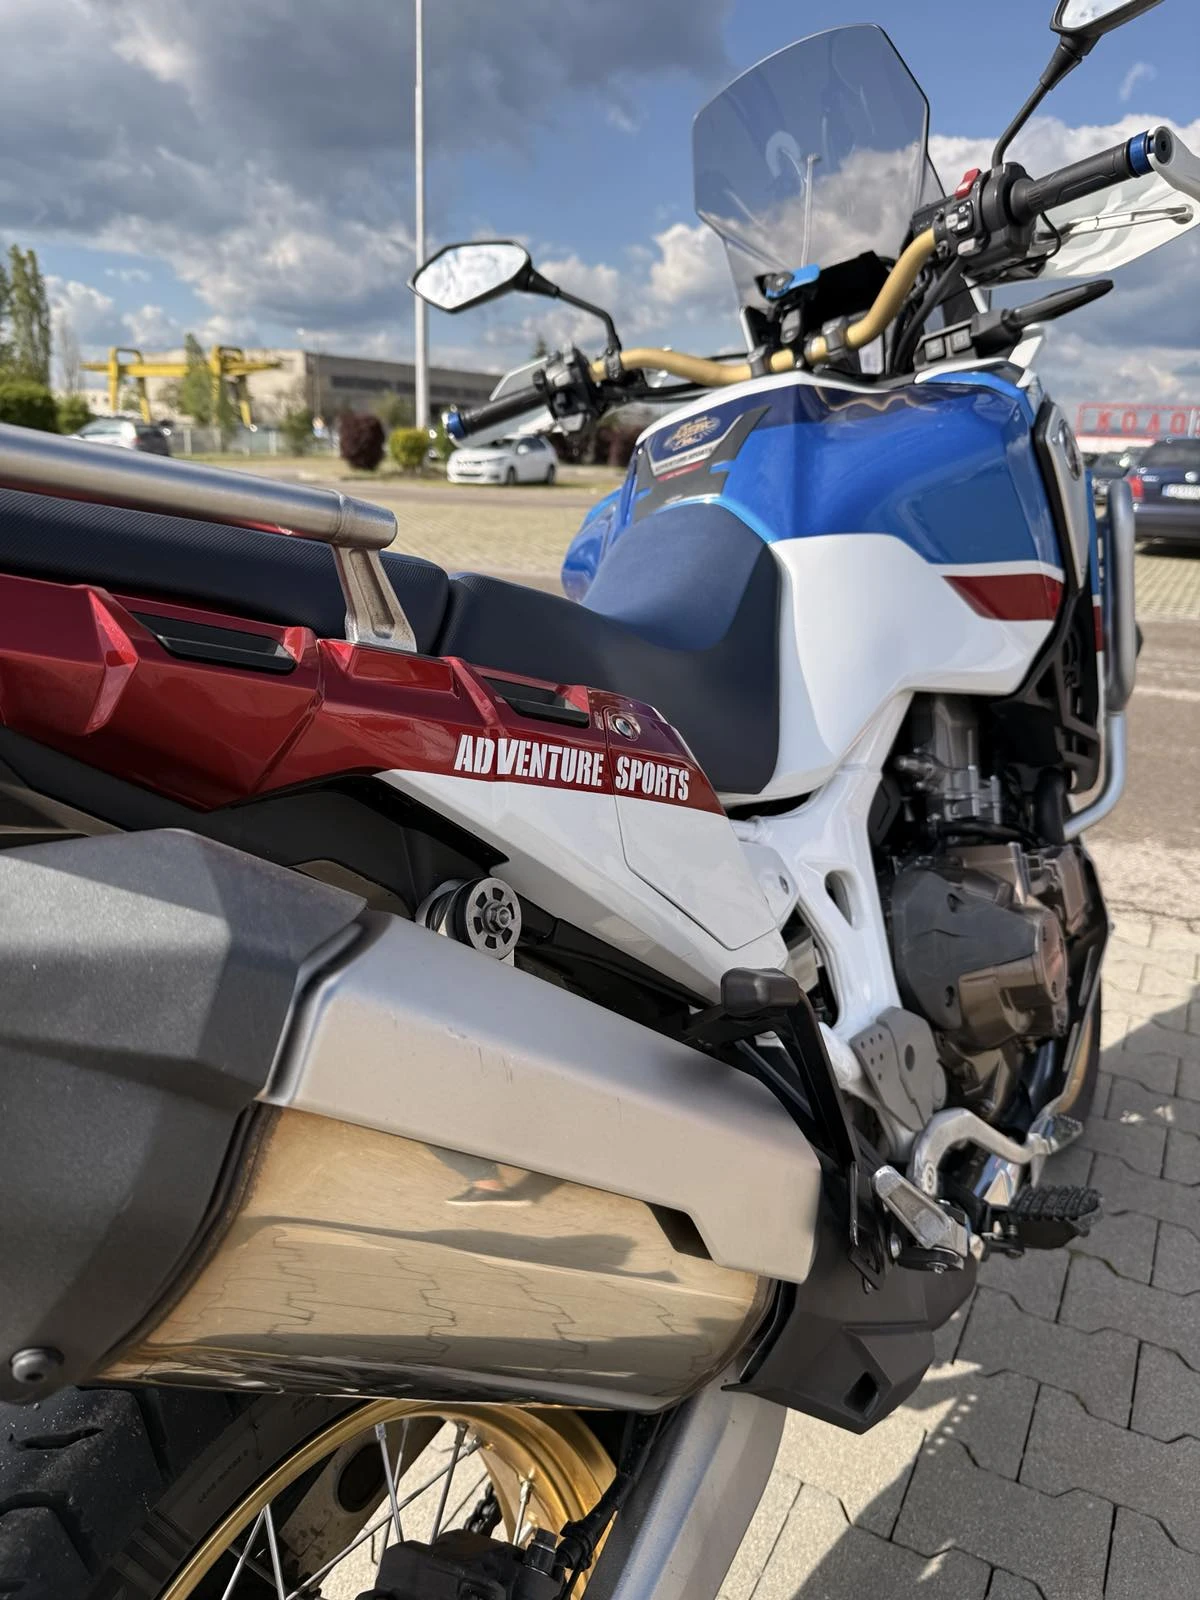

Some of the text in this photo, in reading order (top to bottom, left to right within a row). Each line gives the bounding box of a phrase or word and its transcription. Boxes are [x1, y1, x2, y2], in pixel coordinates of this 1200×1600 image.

[1096, 410, 1200, 437] КОЛО
[454, 734, 689, 801] ADVENTURE SPORTS
